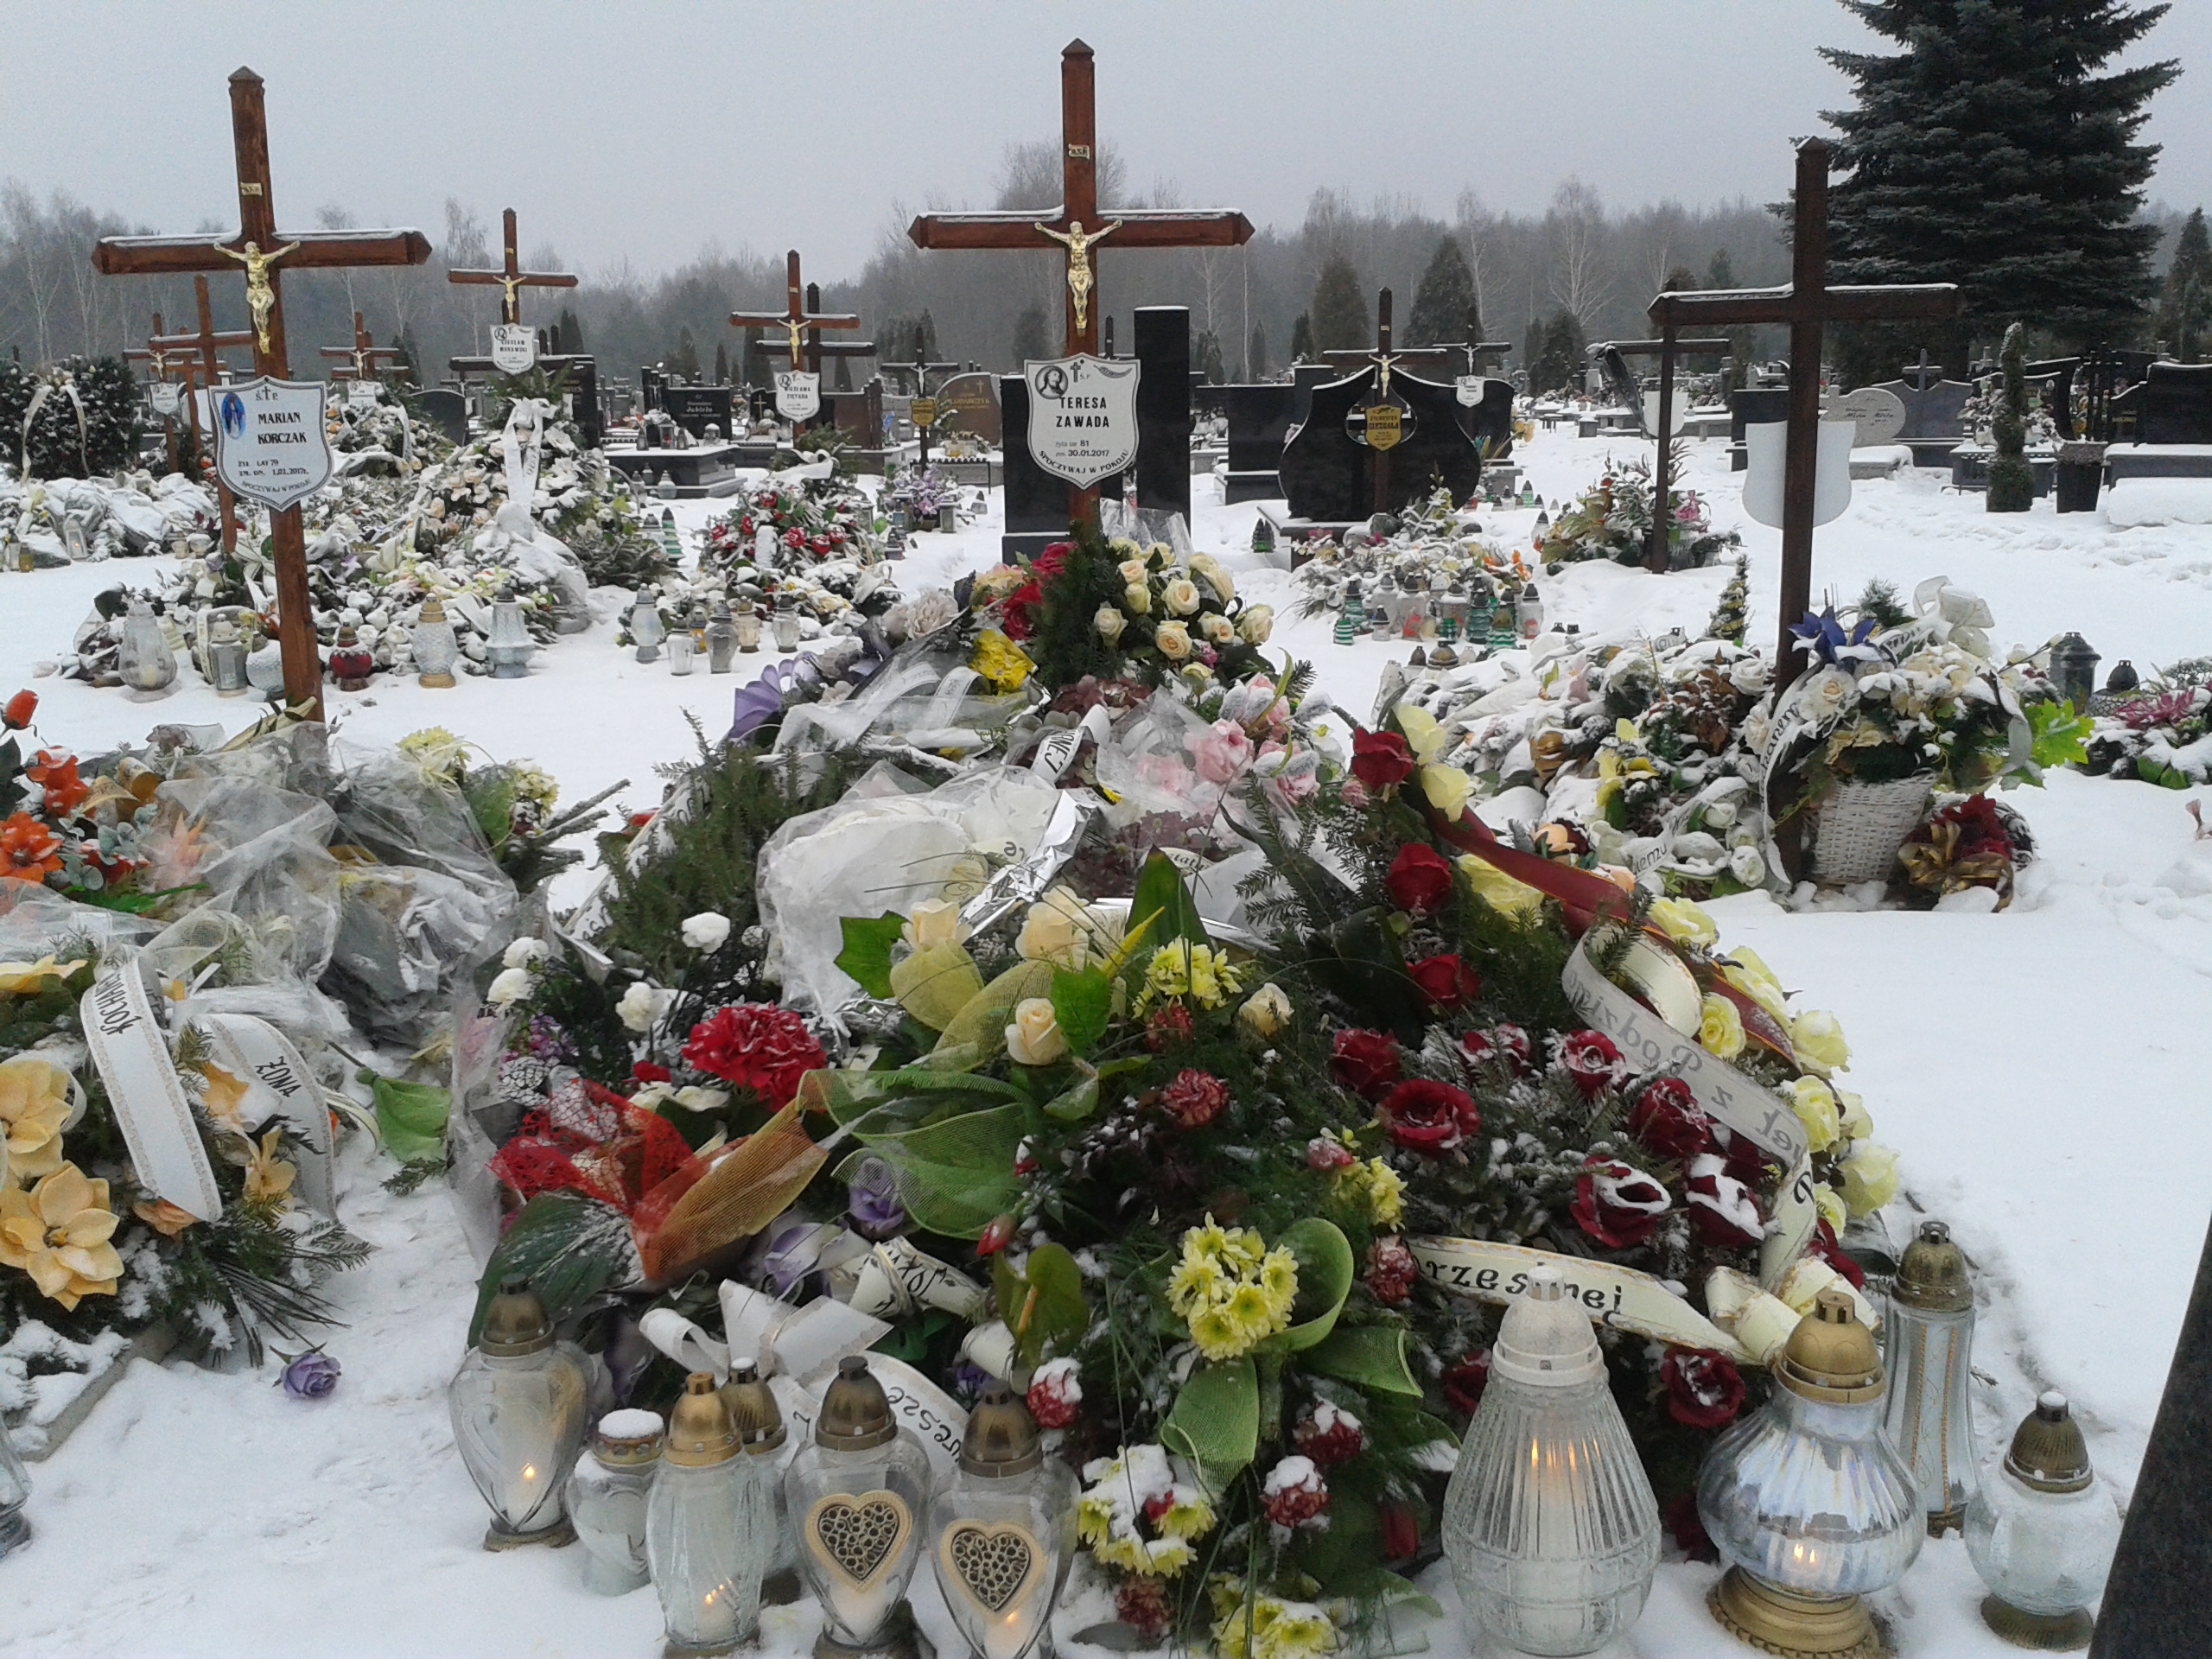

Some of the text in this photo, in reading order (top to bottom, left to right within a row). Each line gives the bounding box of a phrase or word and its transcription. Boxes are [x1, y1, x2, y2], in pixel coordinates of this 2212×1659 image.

[1058, 397, 1107, 409] TERESA
[257, 411, 302, 425] MARIAN
[1055, 416, 1109, 428] ZAWADA
[257, 431, 308, 445] KORCZAK
[1039, 449, 1086, 474] SPOCZYWAJ
[1100, 448, 1129, 472] POKOJU
